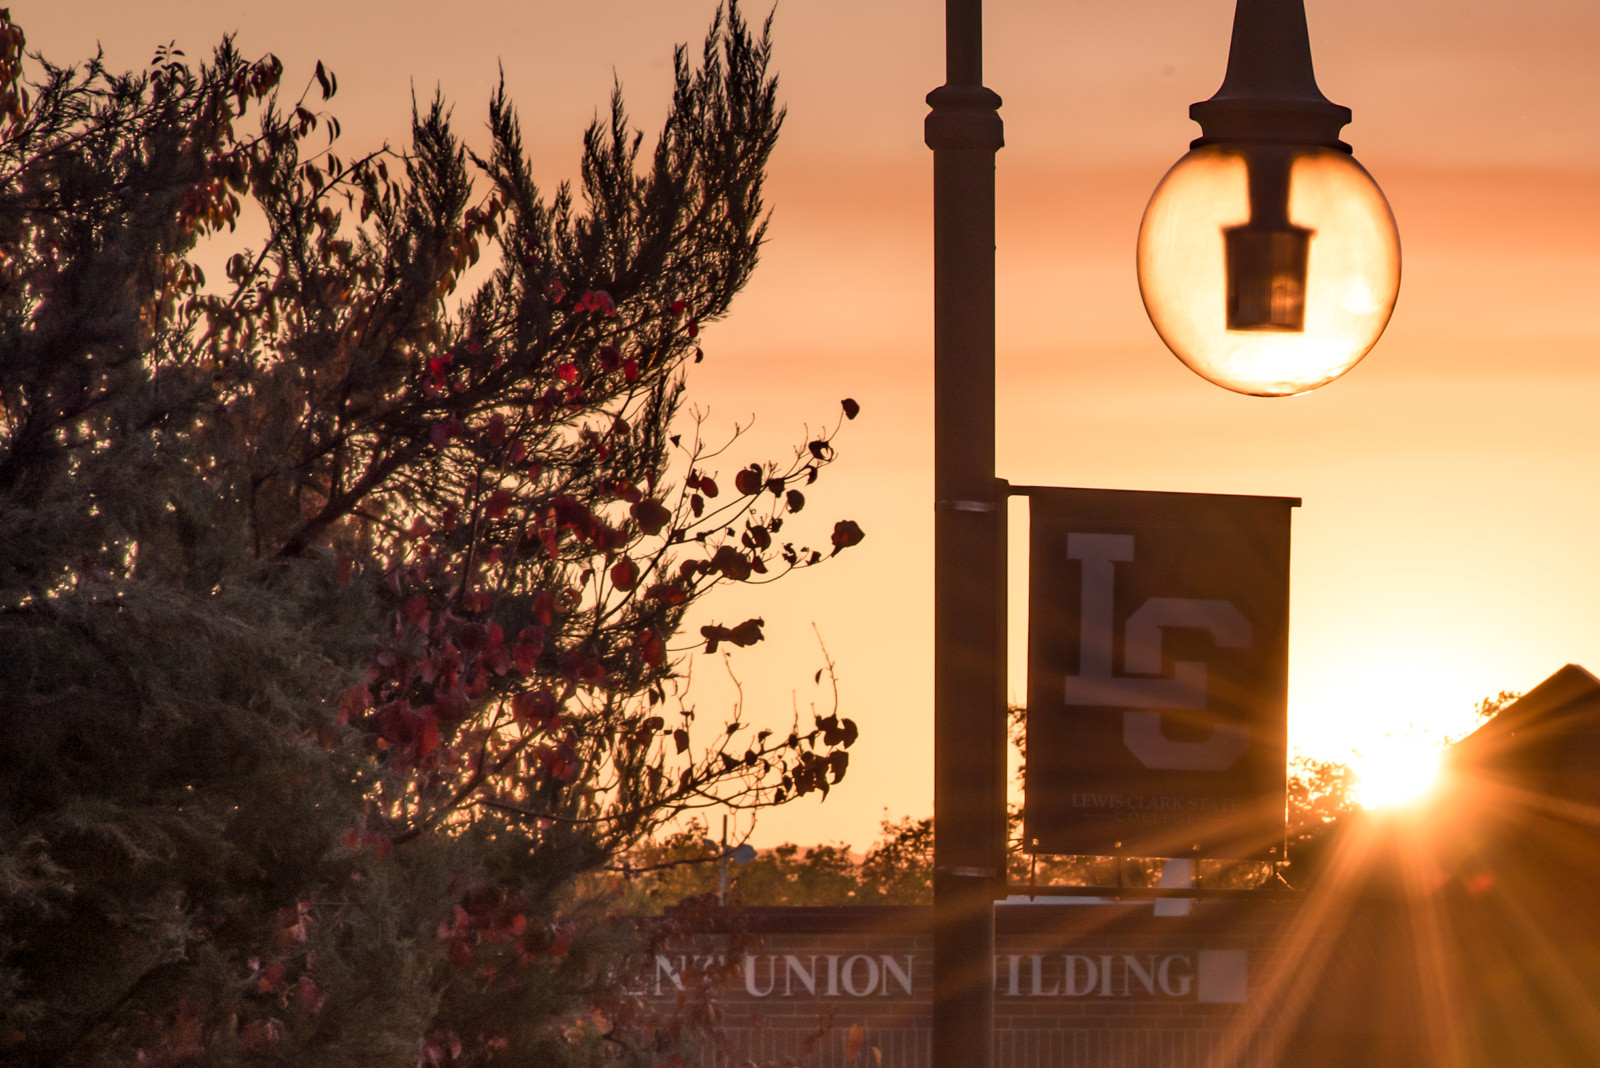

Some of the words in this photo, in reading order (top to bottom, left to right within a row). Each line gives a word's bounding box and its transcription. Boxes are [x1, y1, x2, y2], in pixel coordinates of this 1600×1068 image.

[1188, 797, 1241, 813] STATE
[1115, 811, 1196, 825] COLLEGE
[743, 954, 916, 998] UNION
[994, 953, 1194, 997] ILDING
